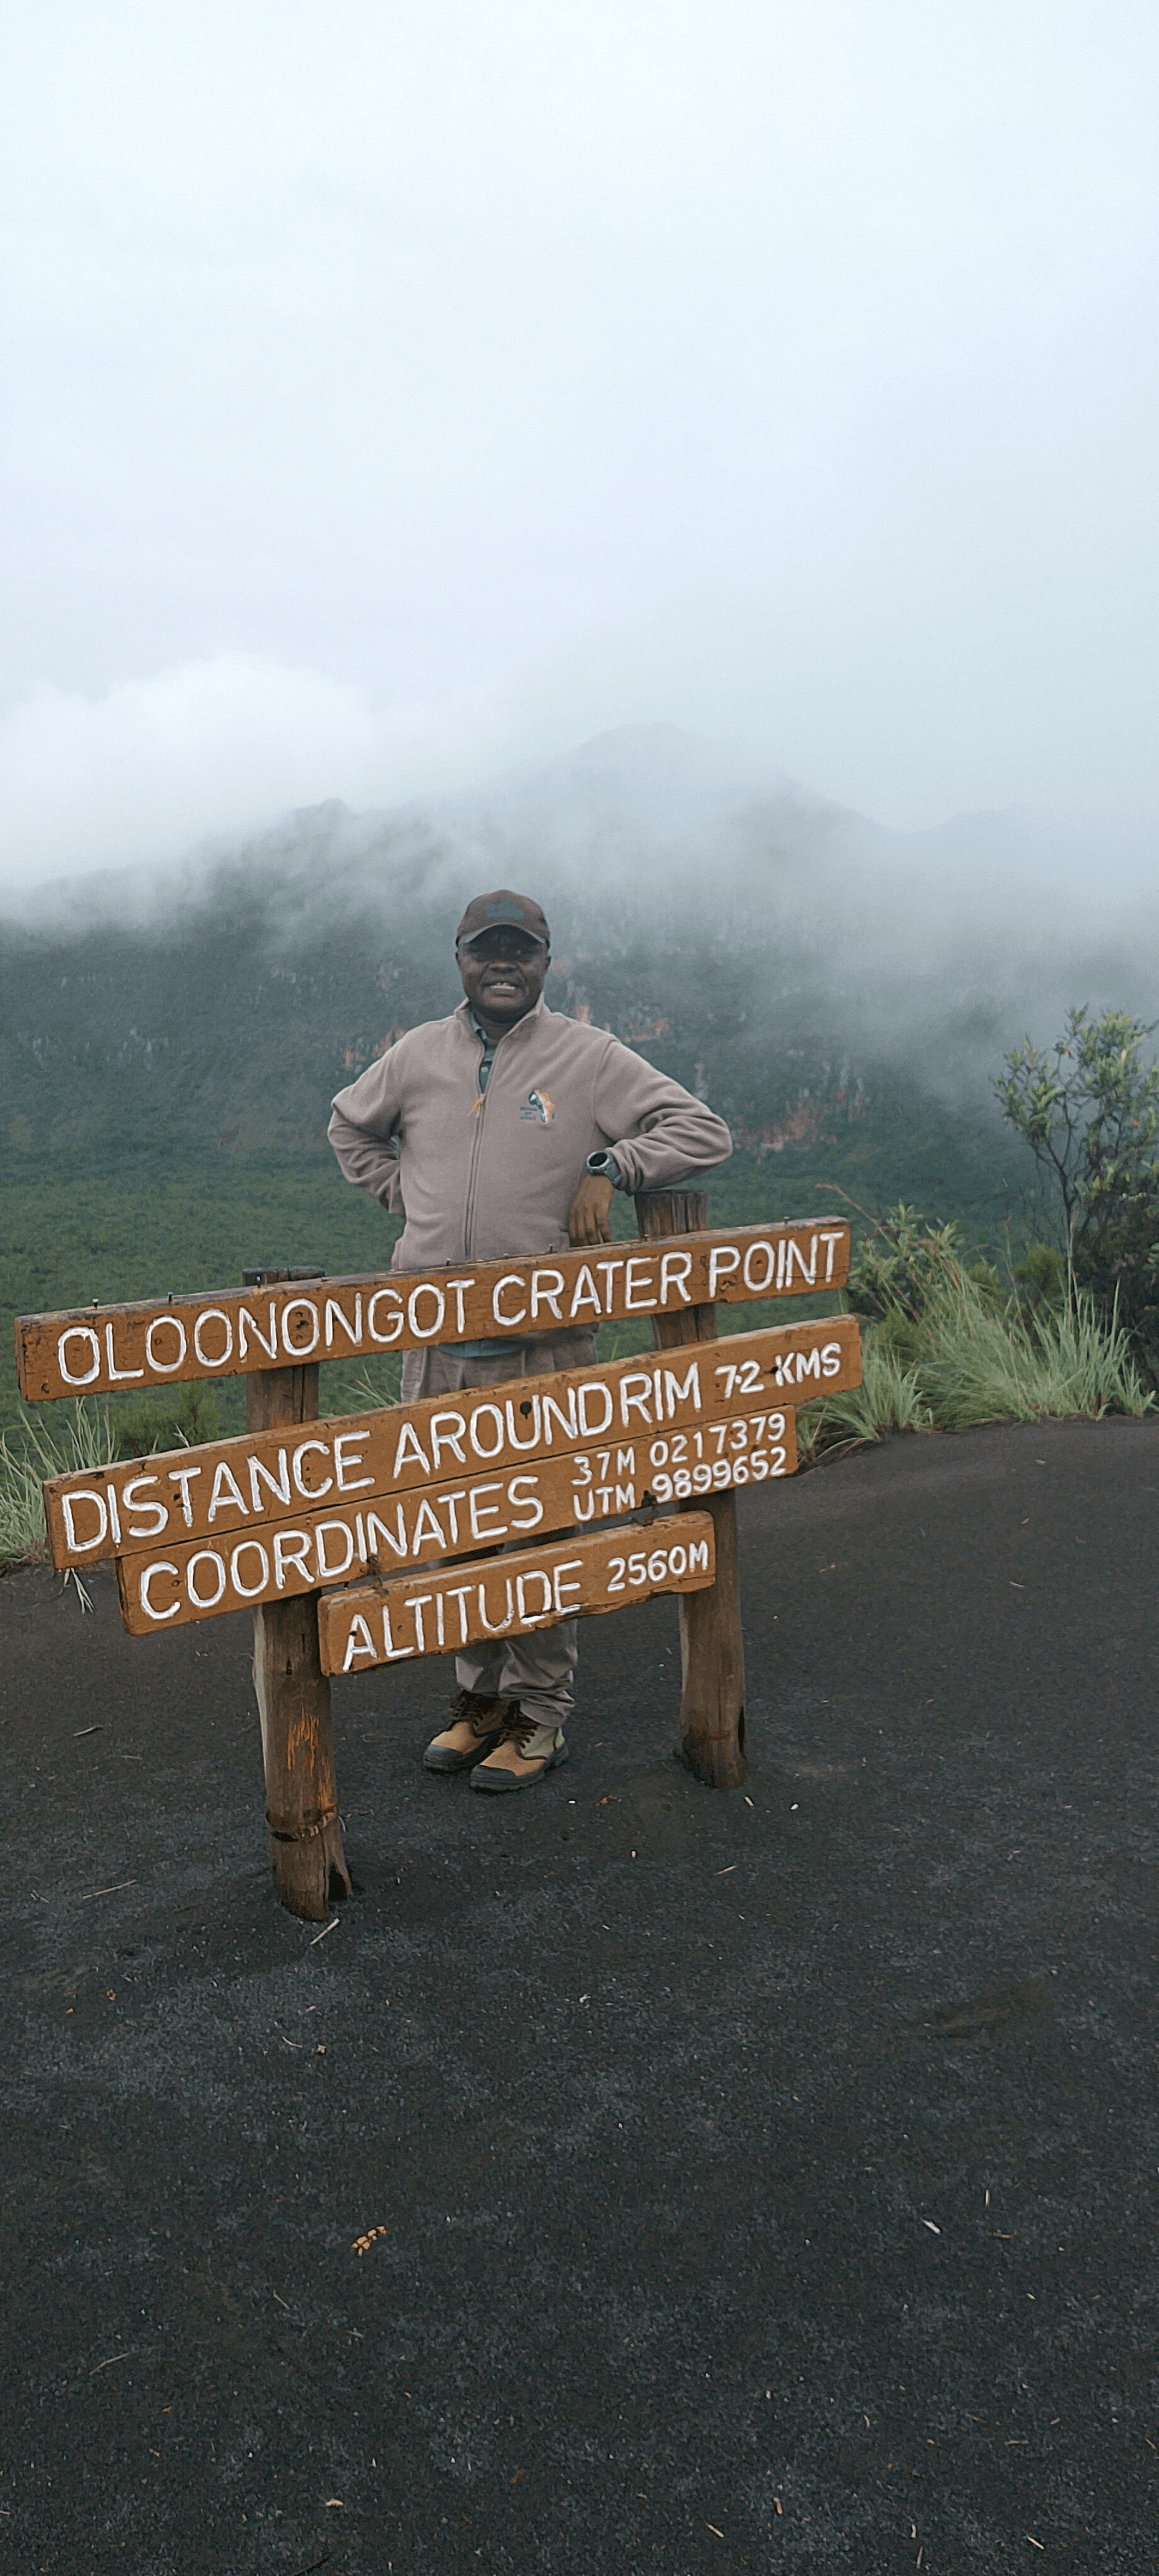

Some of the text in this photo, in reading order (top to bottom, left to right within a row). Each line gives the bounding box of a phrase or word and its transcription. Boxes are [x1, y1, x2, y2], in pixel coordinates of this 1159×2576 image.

[57, 1231, 845, 1386] OLOONONGOT CRATER POINT
[62, 1429, 376, 1553] DISTANCE
[392, 1382, 613, 1479] AROUND
[619, 1362, 703, 1427] RIM
[774, 1342, 841, 1387] KMS
[139, 1411, 787, 1621] COORDINATES 37M 0217379
[573, 1445, 788, 1522] UTM 9899652
[342, 1539, 709, 1672] ALTITUDE 2560M
